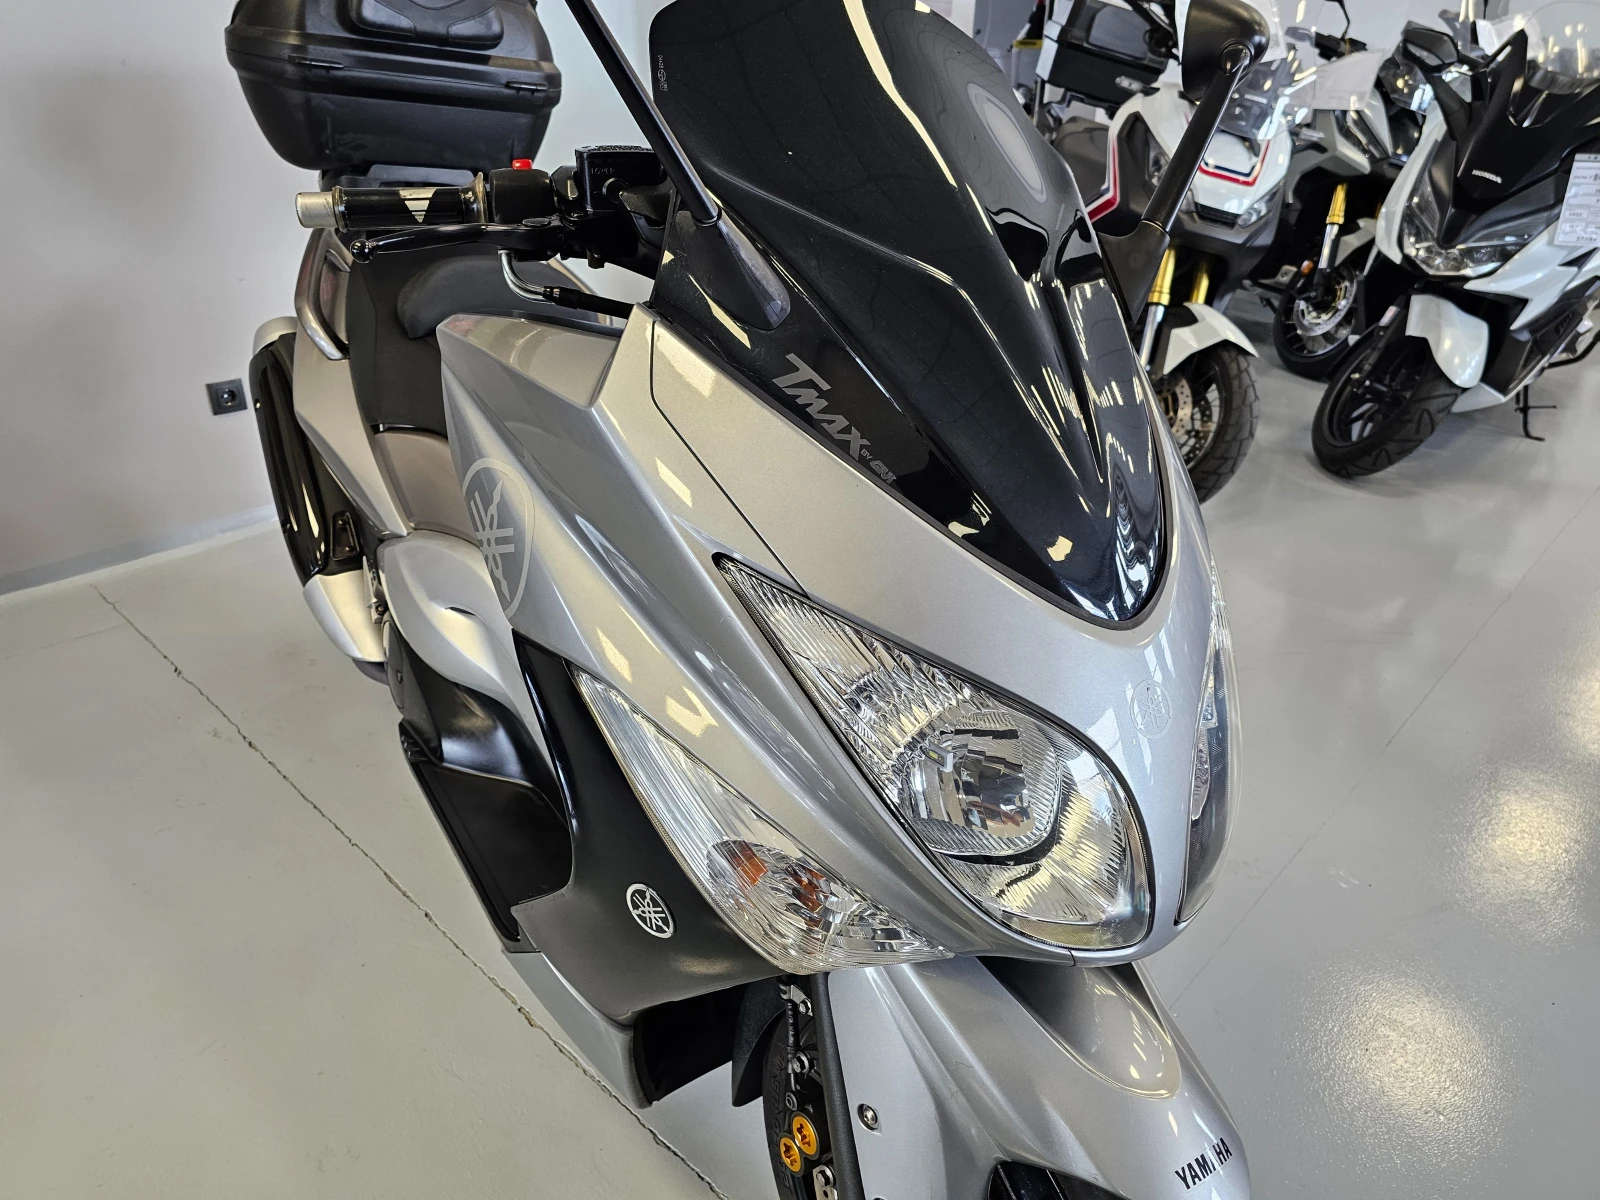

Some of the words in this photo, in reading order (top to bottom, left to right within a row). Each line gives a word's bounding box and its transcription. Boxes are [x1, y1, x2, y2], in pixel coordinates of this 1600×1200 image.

[1471, 169, 1502, 183] HONDA
[772, 352, 872, 461] TMAX
[860, 448, 873, 460] BY
[869, 459, 897, 484] GIVI
